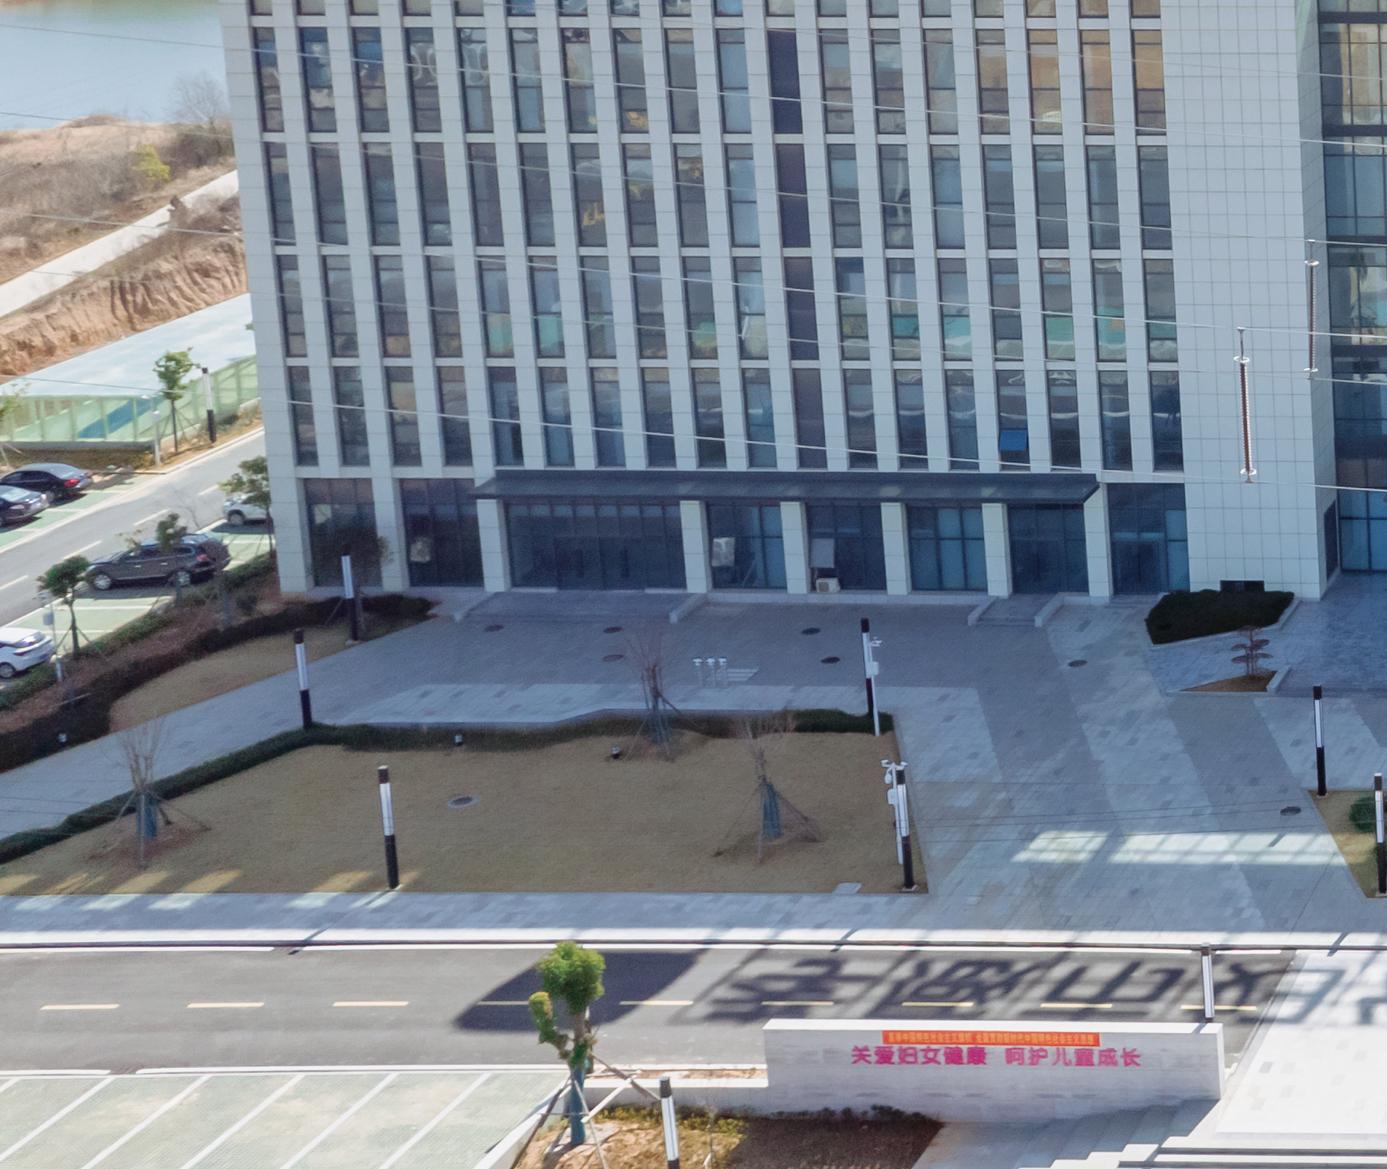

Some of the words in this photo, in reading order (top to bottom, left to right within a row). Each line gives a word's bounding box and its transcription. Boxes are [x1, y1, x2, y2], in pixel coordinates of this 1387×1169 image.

[852, 1045, 987, 1067] 关爱妇女健康
[1005, 1046, 1142, 1068] 呵护儿童成长
